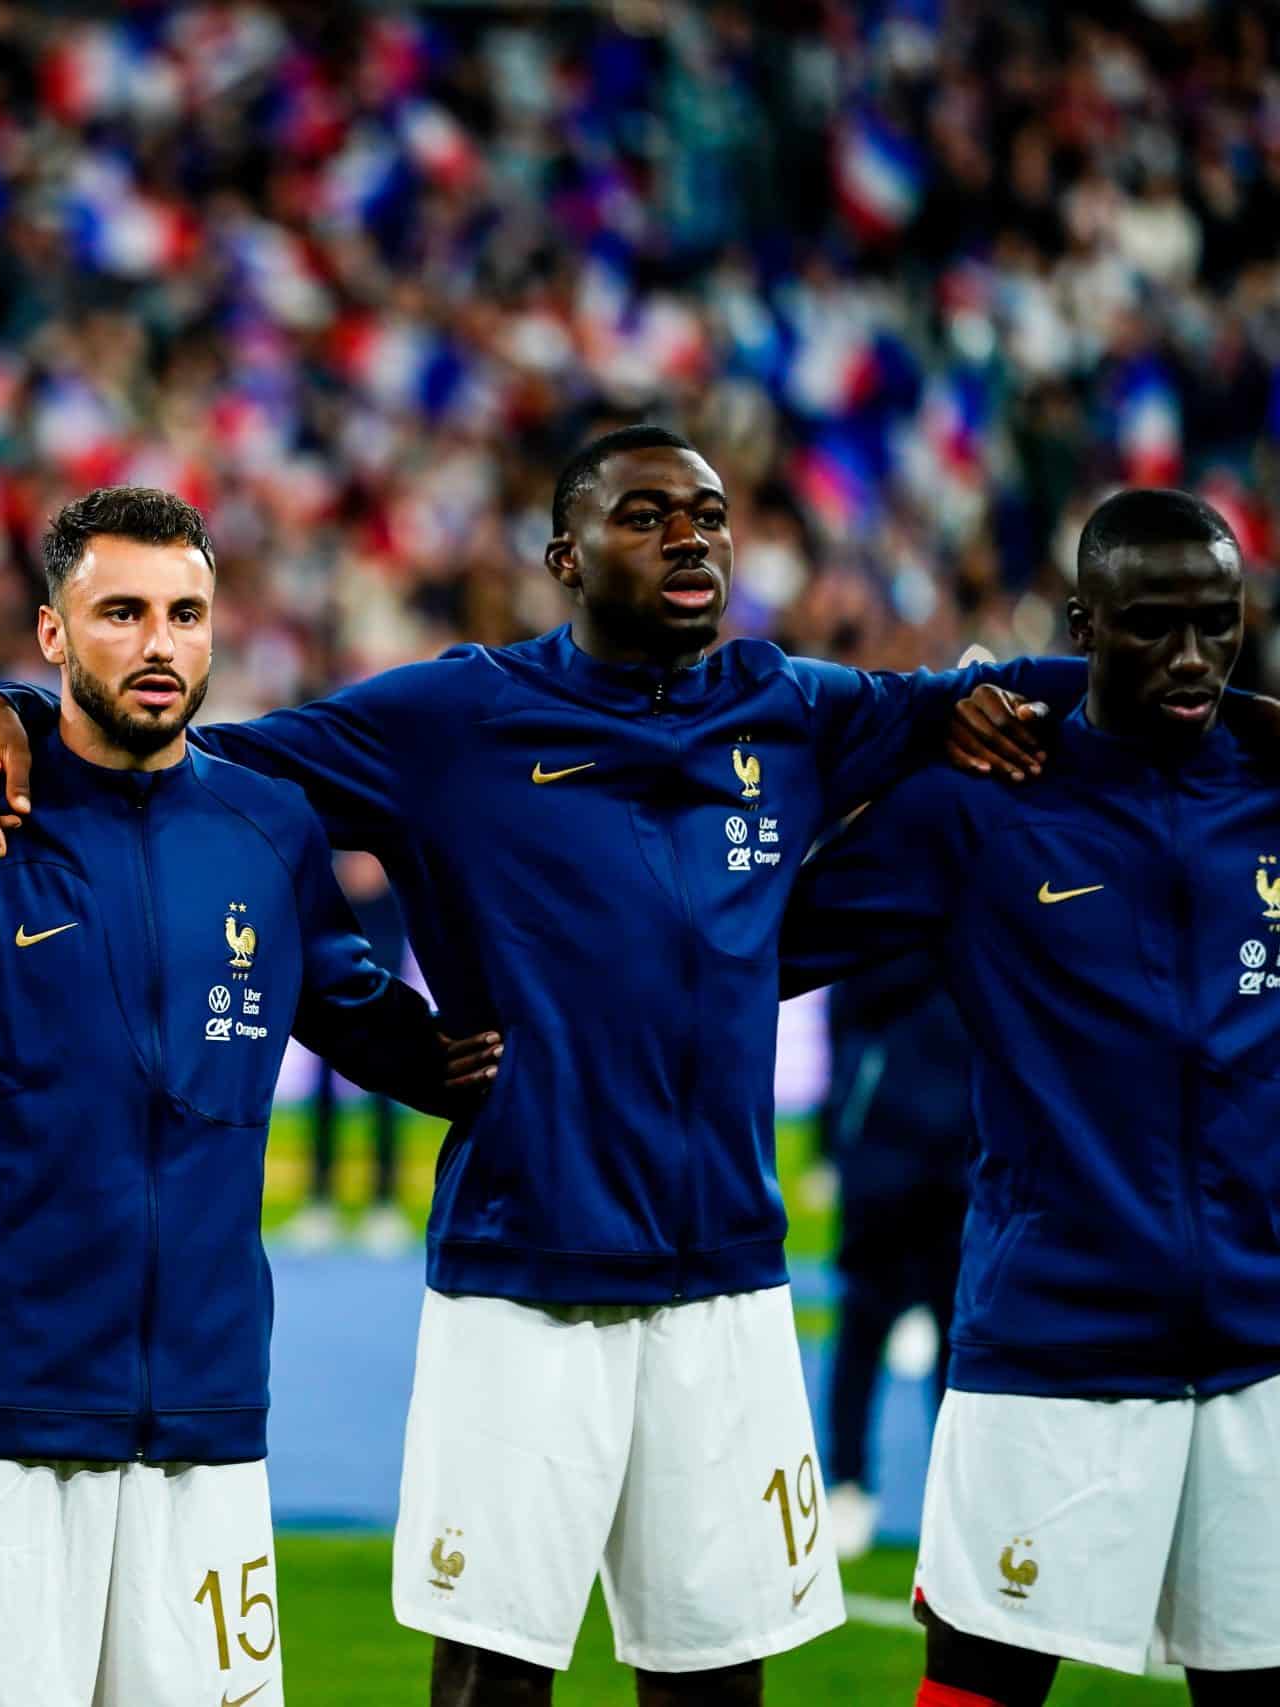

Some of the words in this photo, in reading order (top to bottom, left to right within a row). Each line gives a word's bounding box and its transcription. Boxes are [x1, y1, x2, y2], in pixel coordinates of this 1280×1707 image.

[208, 985, 231, 1013] VW
[244, 988, 262, 1001] Uber
[235, 1022, 267, 1039] Orange
[761, 1453, 819, 1566] 19
[193, 1555, 275, 1670] 15
